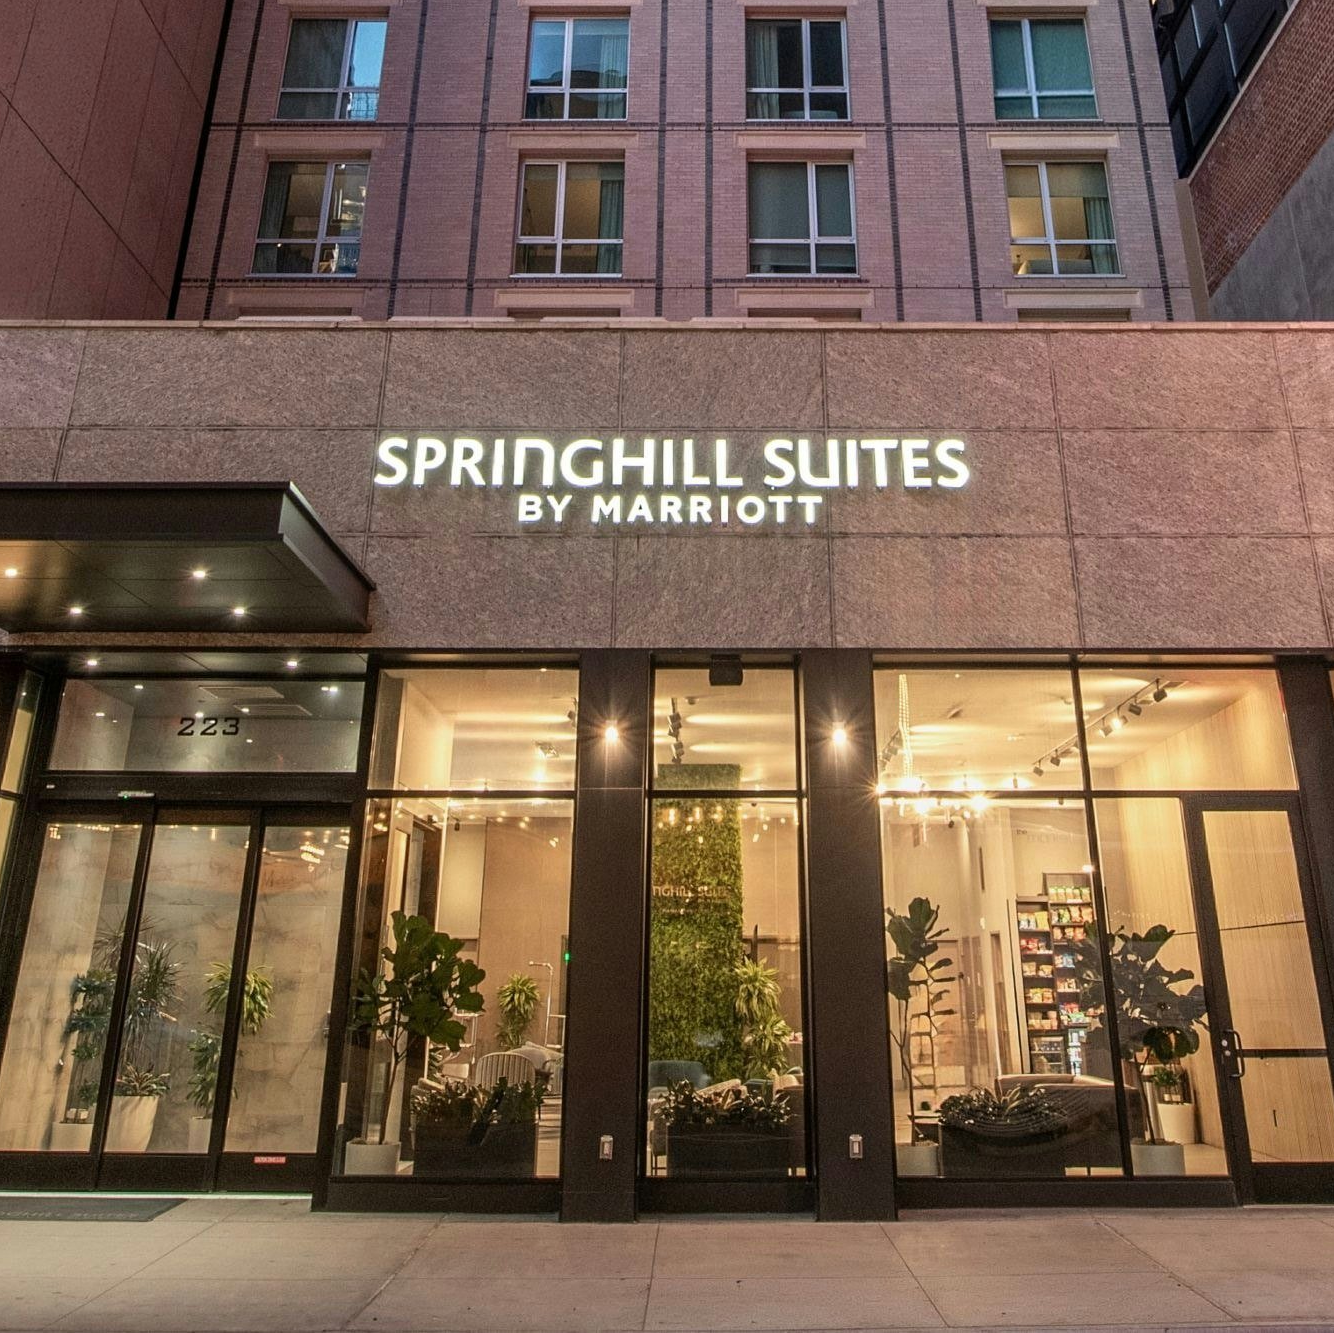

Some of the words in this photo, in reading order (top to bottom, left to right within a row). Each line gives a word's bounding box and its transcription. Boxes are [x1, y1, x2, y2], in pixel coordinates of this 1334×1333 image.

[374, 438, 744, 488] SPRINGHILL
[764, 439, 969, 489] SUITES
[518, 495, 573, 523] BY
[591, 495, 823, 524] MARRIOTT
[177, 717, 240, 736] 223
